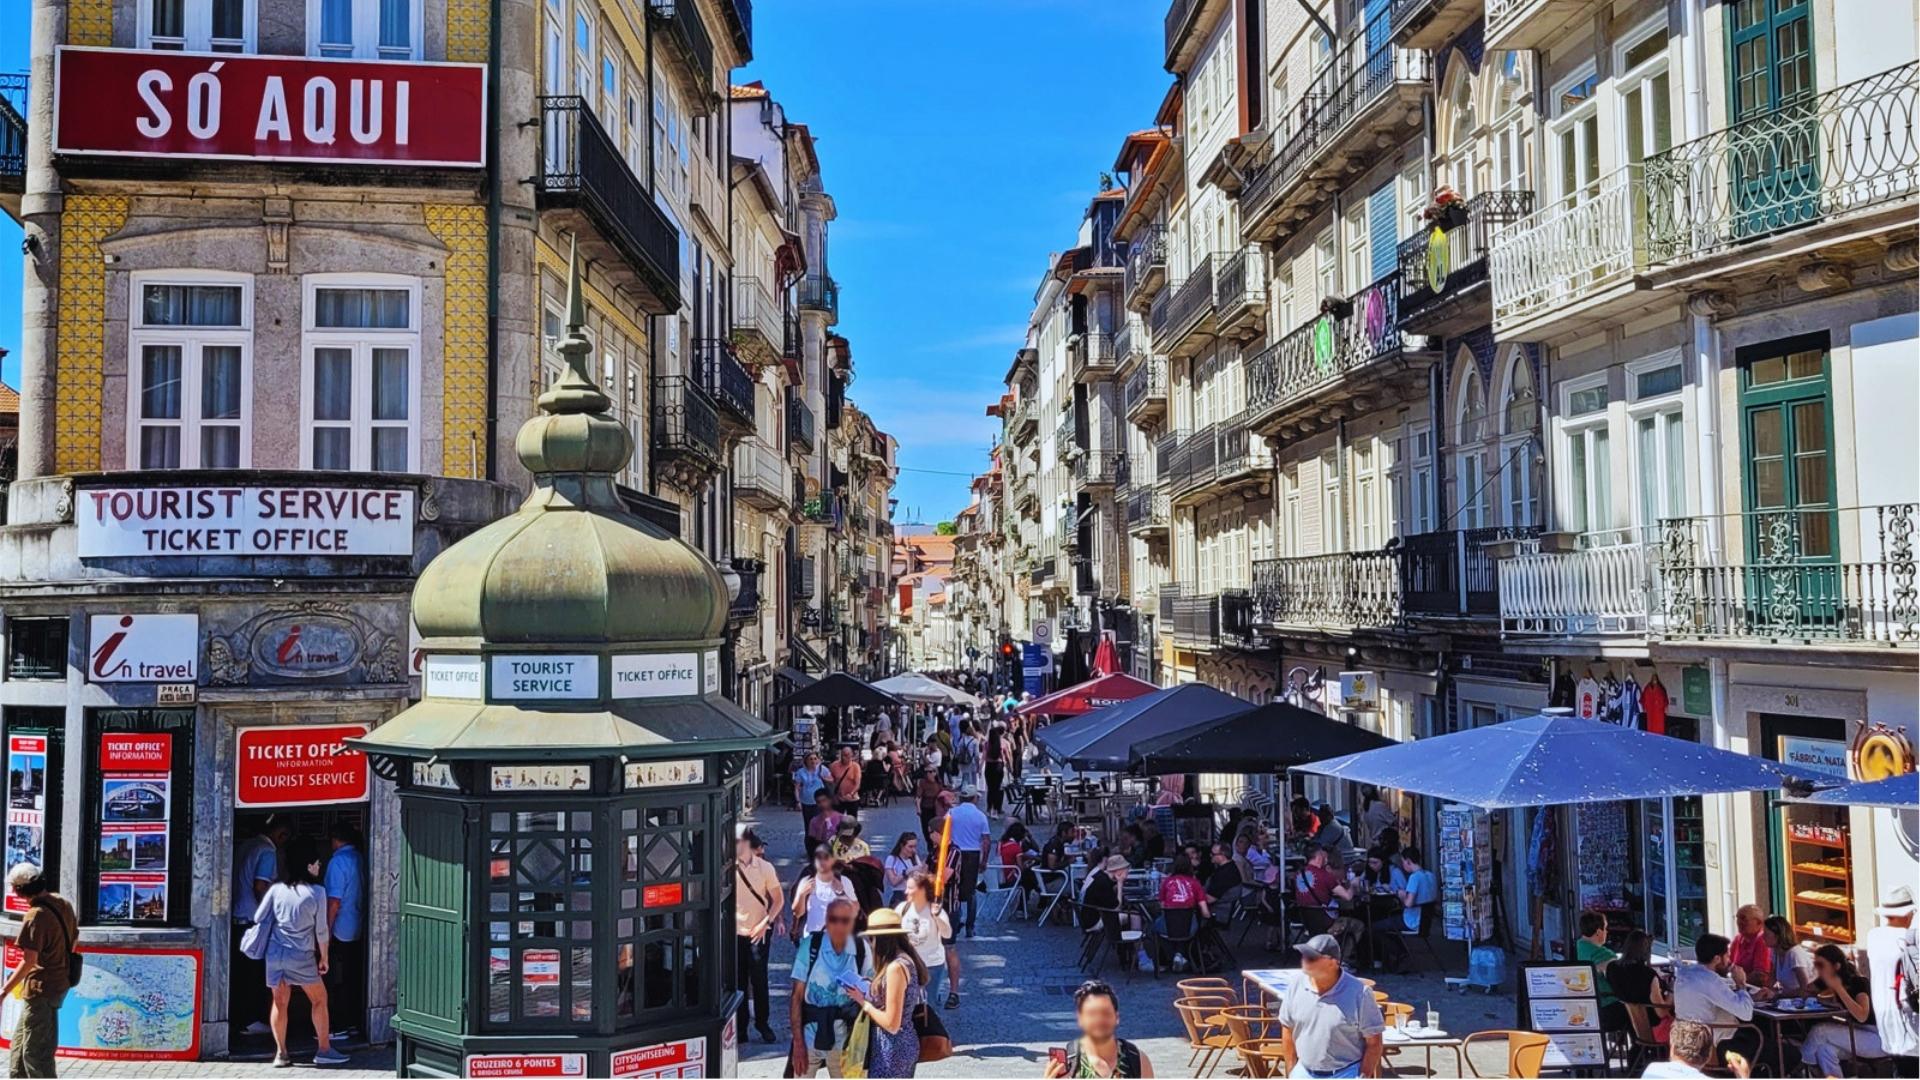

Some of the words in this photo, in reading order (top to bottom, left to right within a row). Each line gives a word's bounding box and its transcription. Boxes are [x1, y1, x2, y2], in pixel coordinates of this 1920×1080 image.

[136, 61, 225, 140] SÓ
[255, 76, 409, 145] AQUI
[90, 489, 242, 521] TOURIST
[258, 490, 402, 521] SERVICE
[143, 529, 241, 551] TICKET
[253, 529, 348, 551] OFFICE
[307, 652, 338, 664] travel
[139, 660, 193, 678] travel
[512, 662, 574, 674] TOURIST
[430, 670, 453, 682] TICKET
[456, 671, 479, 682] OFFICE
[617, 671, 654, 682] TICKET
[658, 669, 693, 680] OFFICE
[513, 680, 572, 692] SERVICE
[1784, 695, 1799, 707] 301
[107, 742, 133, 751] TICKET
[135, 742, 160, 751] OFFICE
[248, 745, 303, 760] TICKET
[109, 752, 163, 760] INFORMATION
[1825, 756, 1847, 768] NATA
[276, 759, 333, 768] INFORMATION
[252, 774, 305, 788] TOURIST
[309, 771, 355, 786] SERVICE
[615, 1046, 675, 1066] CITYSIGHTSEEING
[472, 1060, 513, 1069] CRUZEIRO
[515, 1059, 521, 1068] 6
[524, 1058, 557, 1068] PONTES
